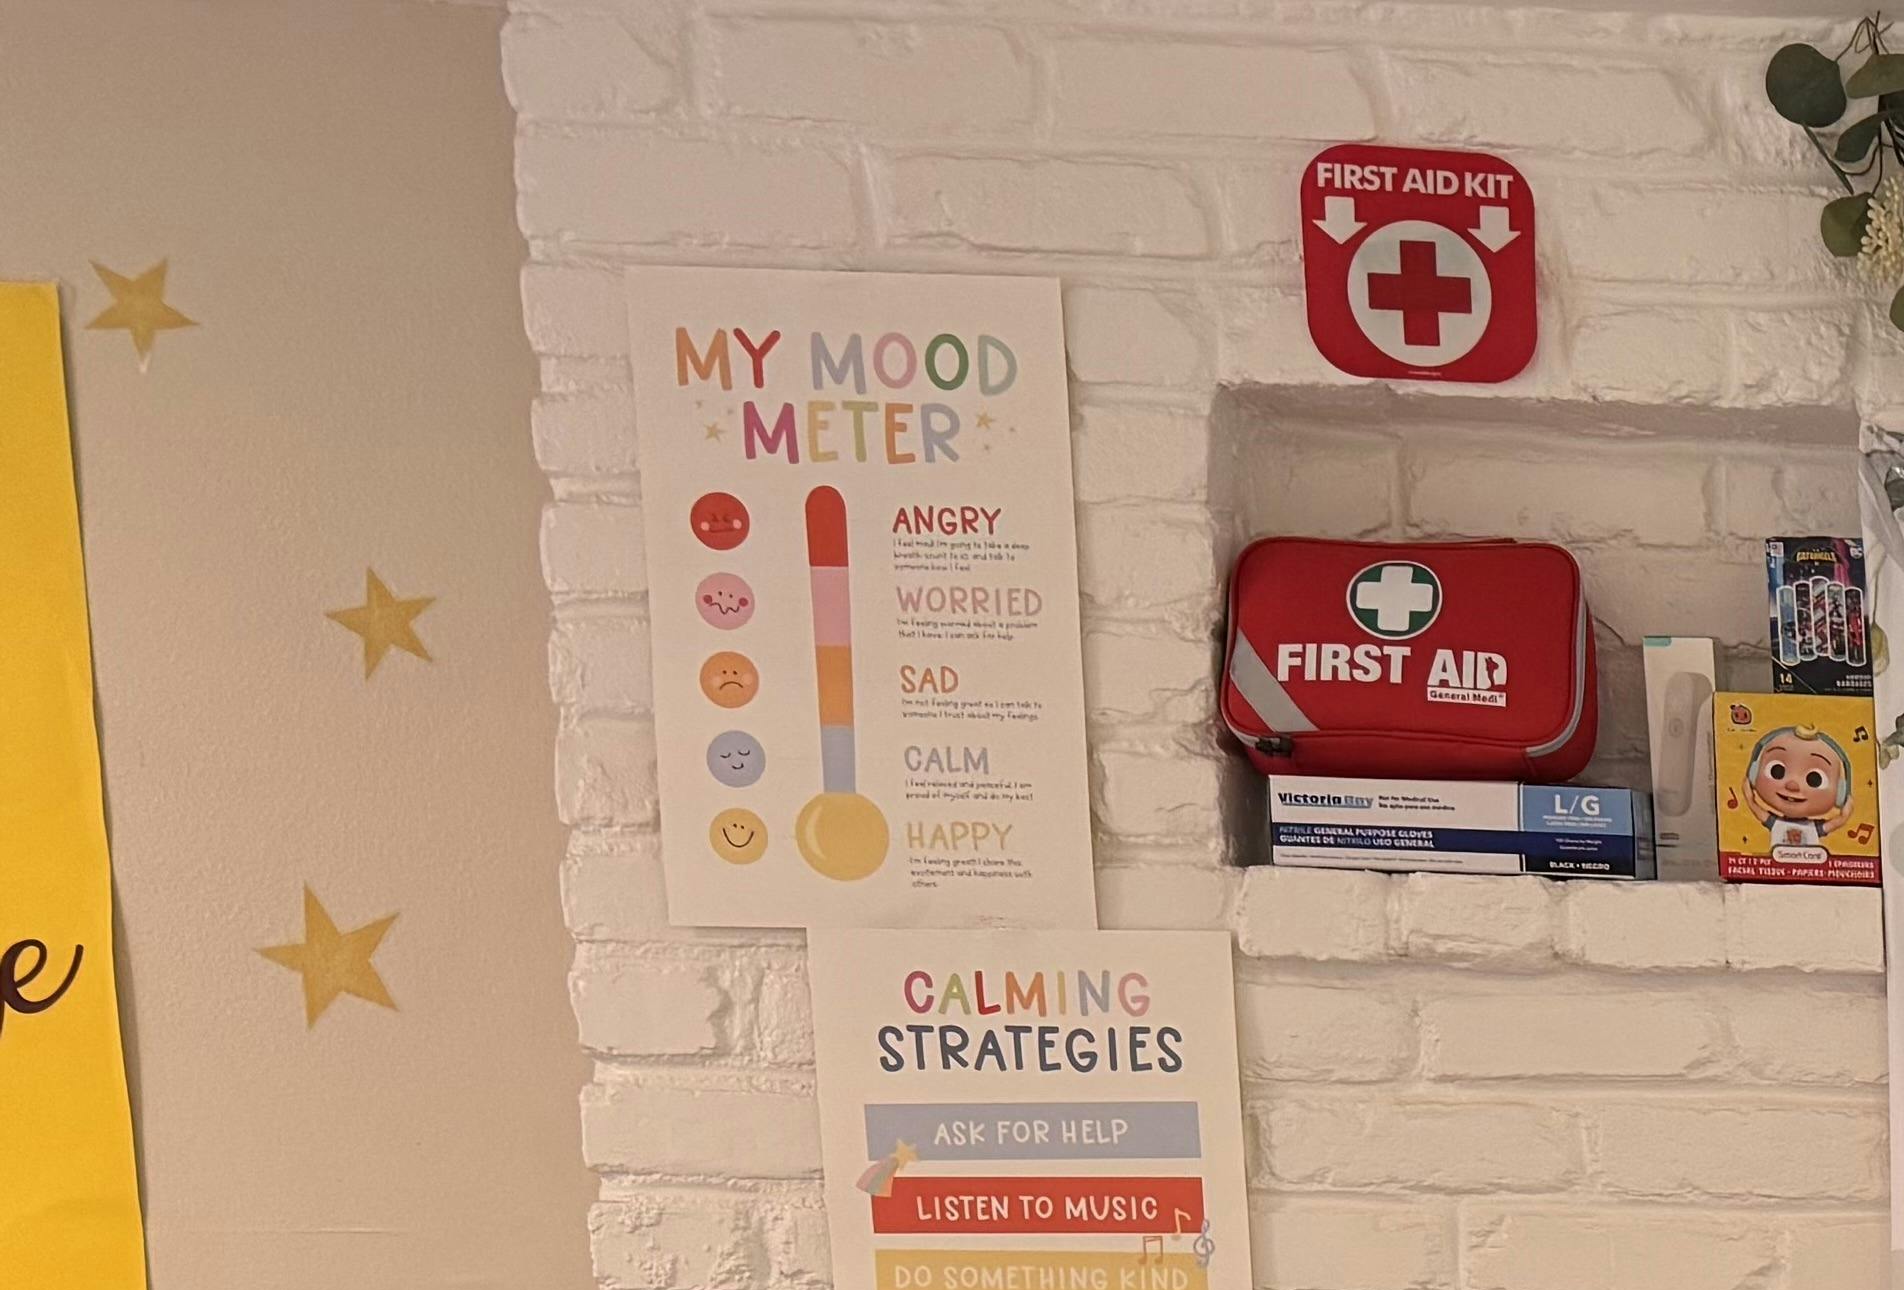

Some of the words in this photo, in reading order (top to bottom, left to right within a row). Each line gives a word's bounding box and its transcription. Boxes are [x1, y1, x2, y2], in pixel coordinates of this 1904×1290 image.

[1316, 162, 1397, 193] FIRST
[1402, 169, 1460, 196] AID
[1464, 172, 1514, 200] KIT
[675, 327, 781, 391] MY
[810, 331, 1018, 396] MOOD
[743, 400, 961, 465] METER
[892, 505, 1002, 535] ANGRY
[896, 586, 1043, 617] WORRIED
[900, 665, 960, 694] SAD
[1277, 643, 1412, 684] FIRST
[1427, 649, 1508, 690] AID
[904, 745, 989, 774] CALM
[1278, 792, 1342, 805] Victoria
[1554, 794, 1600, 816] L/G
[907, 821, 1012, 851] HAPPY
[1279, 834, 1321, 843] GUANTES
[1323, 835, 1335, 844] DE
[1372, 837, 1392, 846] USO
[1393, 838, 1434, 848] GENERAL
[1314, 827, 1353, 836] GENERAL
[1355, 828, 1397, 838] PURPOSE
[1398, 829, 1433, 839] GLOVES
[904, 970, 1151, 1017] CALMING
[878, 1025, 1183, 1073] STRATEGIES
[934, 1121, 986, 1145] ASK
[997, 1121, 1049, 1144] FOR
[1062, 1119, 1129, 1145] HELP
[916, 1195, 1009, 1221] LISTEN
[1019, 1195, 1053, 1219] TO
[1065, 1196, 1158, 1221] MUSIC
[894, 1265, 932, 1290] DO
[944, 1265, 1107, 1290] SOMETHING
[1113, 1265, 1188, 1290] KIND
